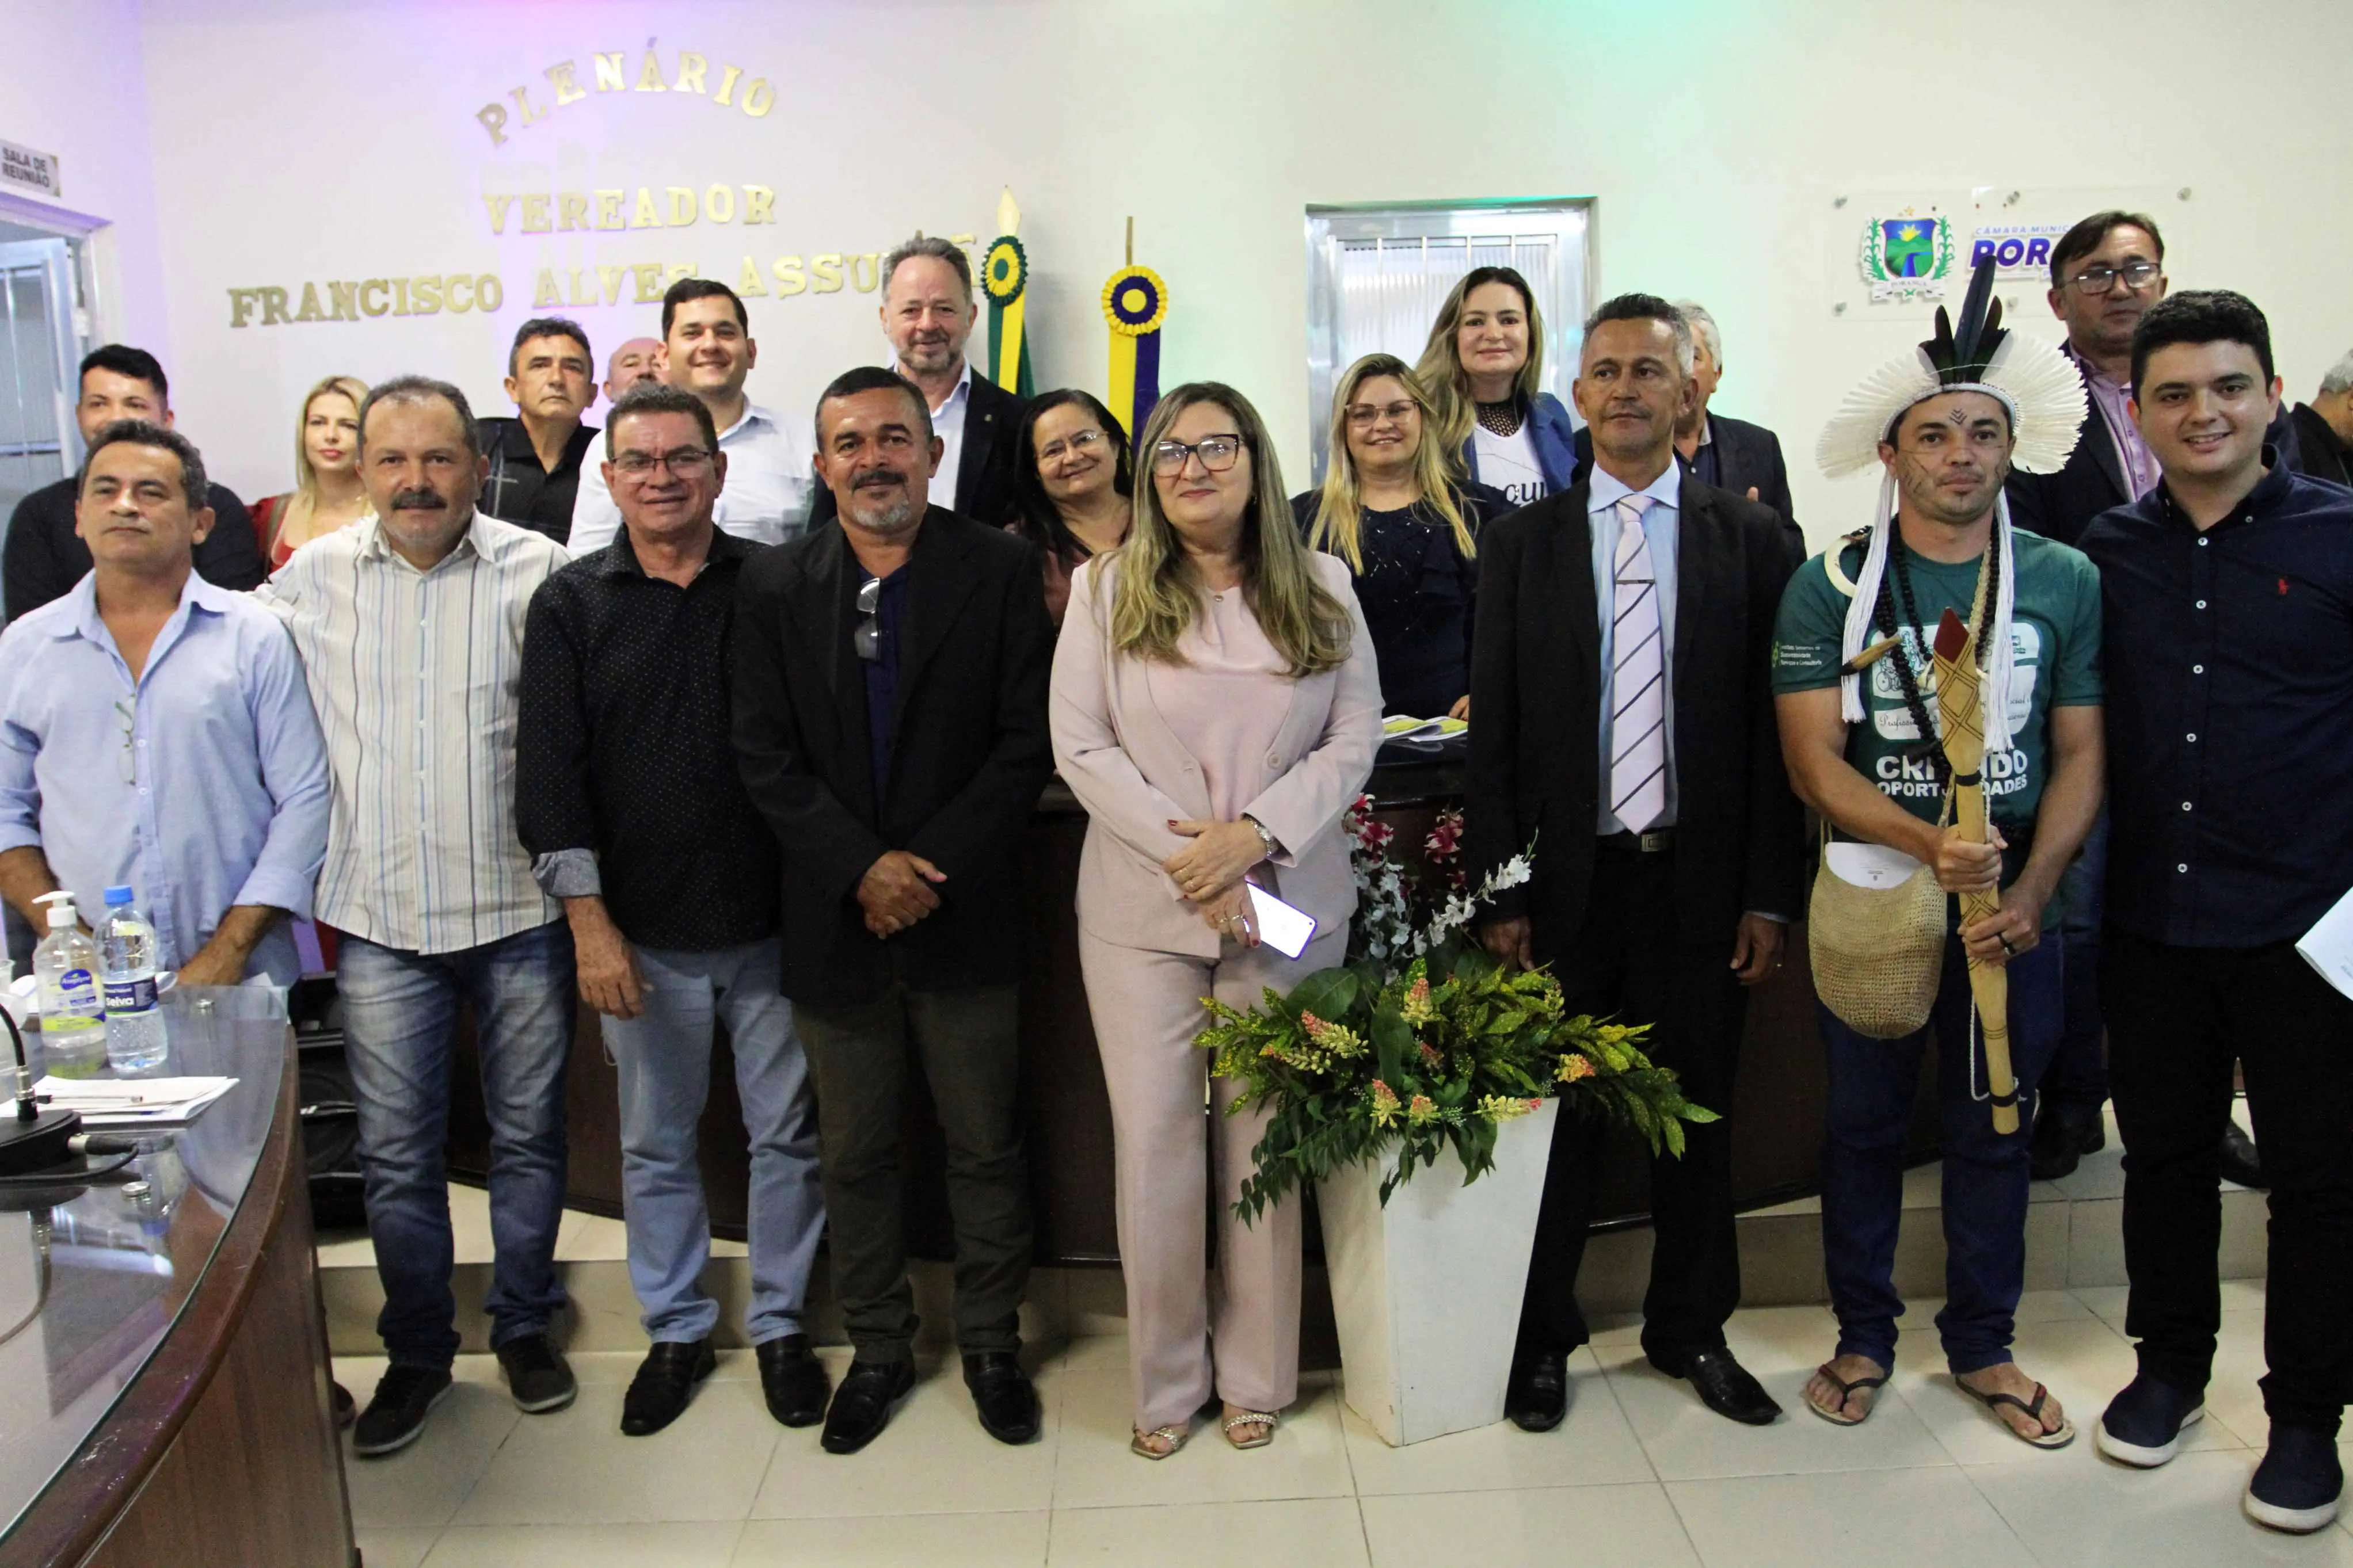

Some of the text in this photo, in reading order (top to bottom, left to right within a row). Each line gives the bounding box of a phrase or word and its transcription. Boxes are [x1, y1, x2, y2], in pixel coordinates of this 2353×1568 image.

[475, 36, 776, 146] PLENÁRIO
[2, 147, 47, 173] SALA DE
[482, 183, 777, 235] VEREADOR
[2030, 224, 2074, 233] MUNIC
[1970, 238, 2051, 268] POR
[226, 273, 502, 328] FRANCISCO
